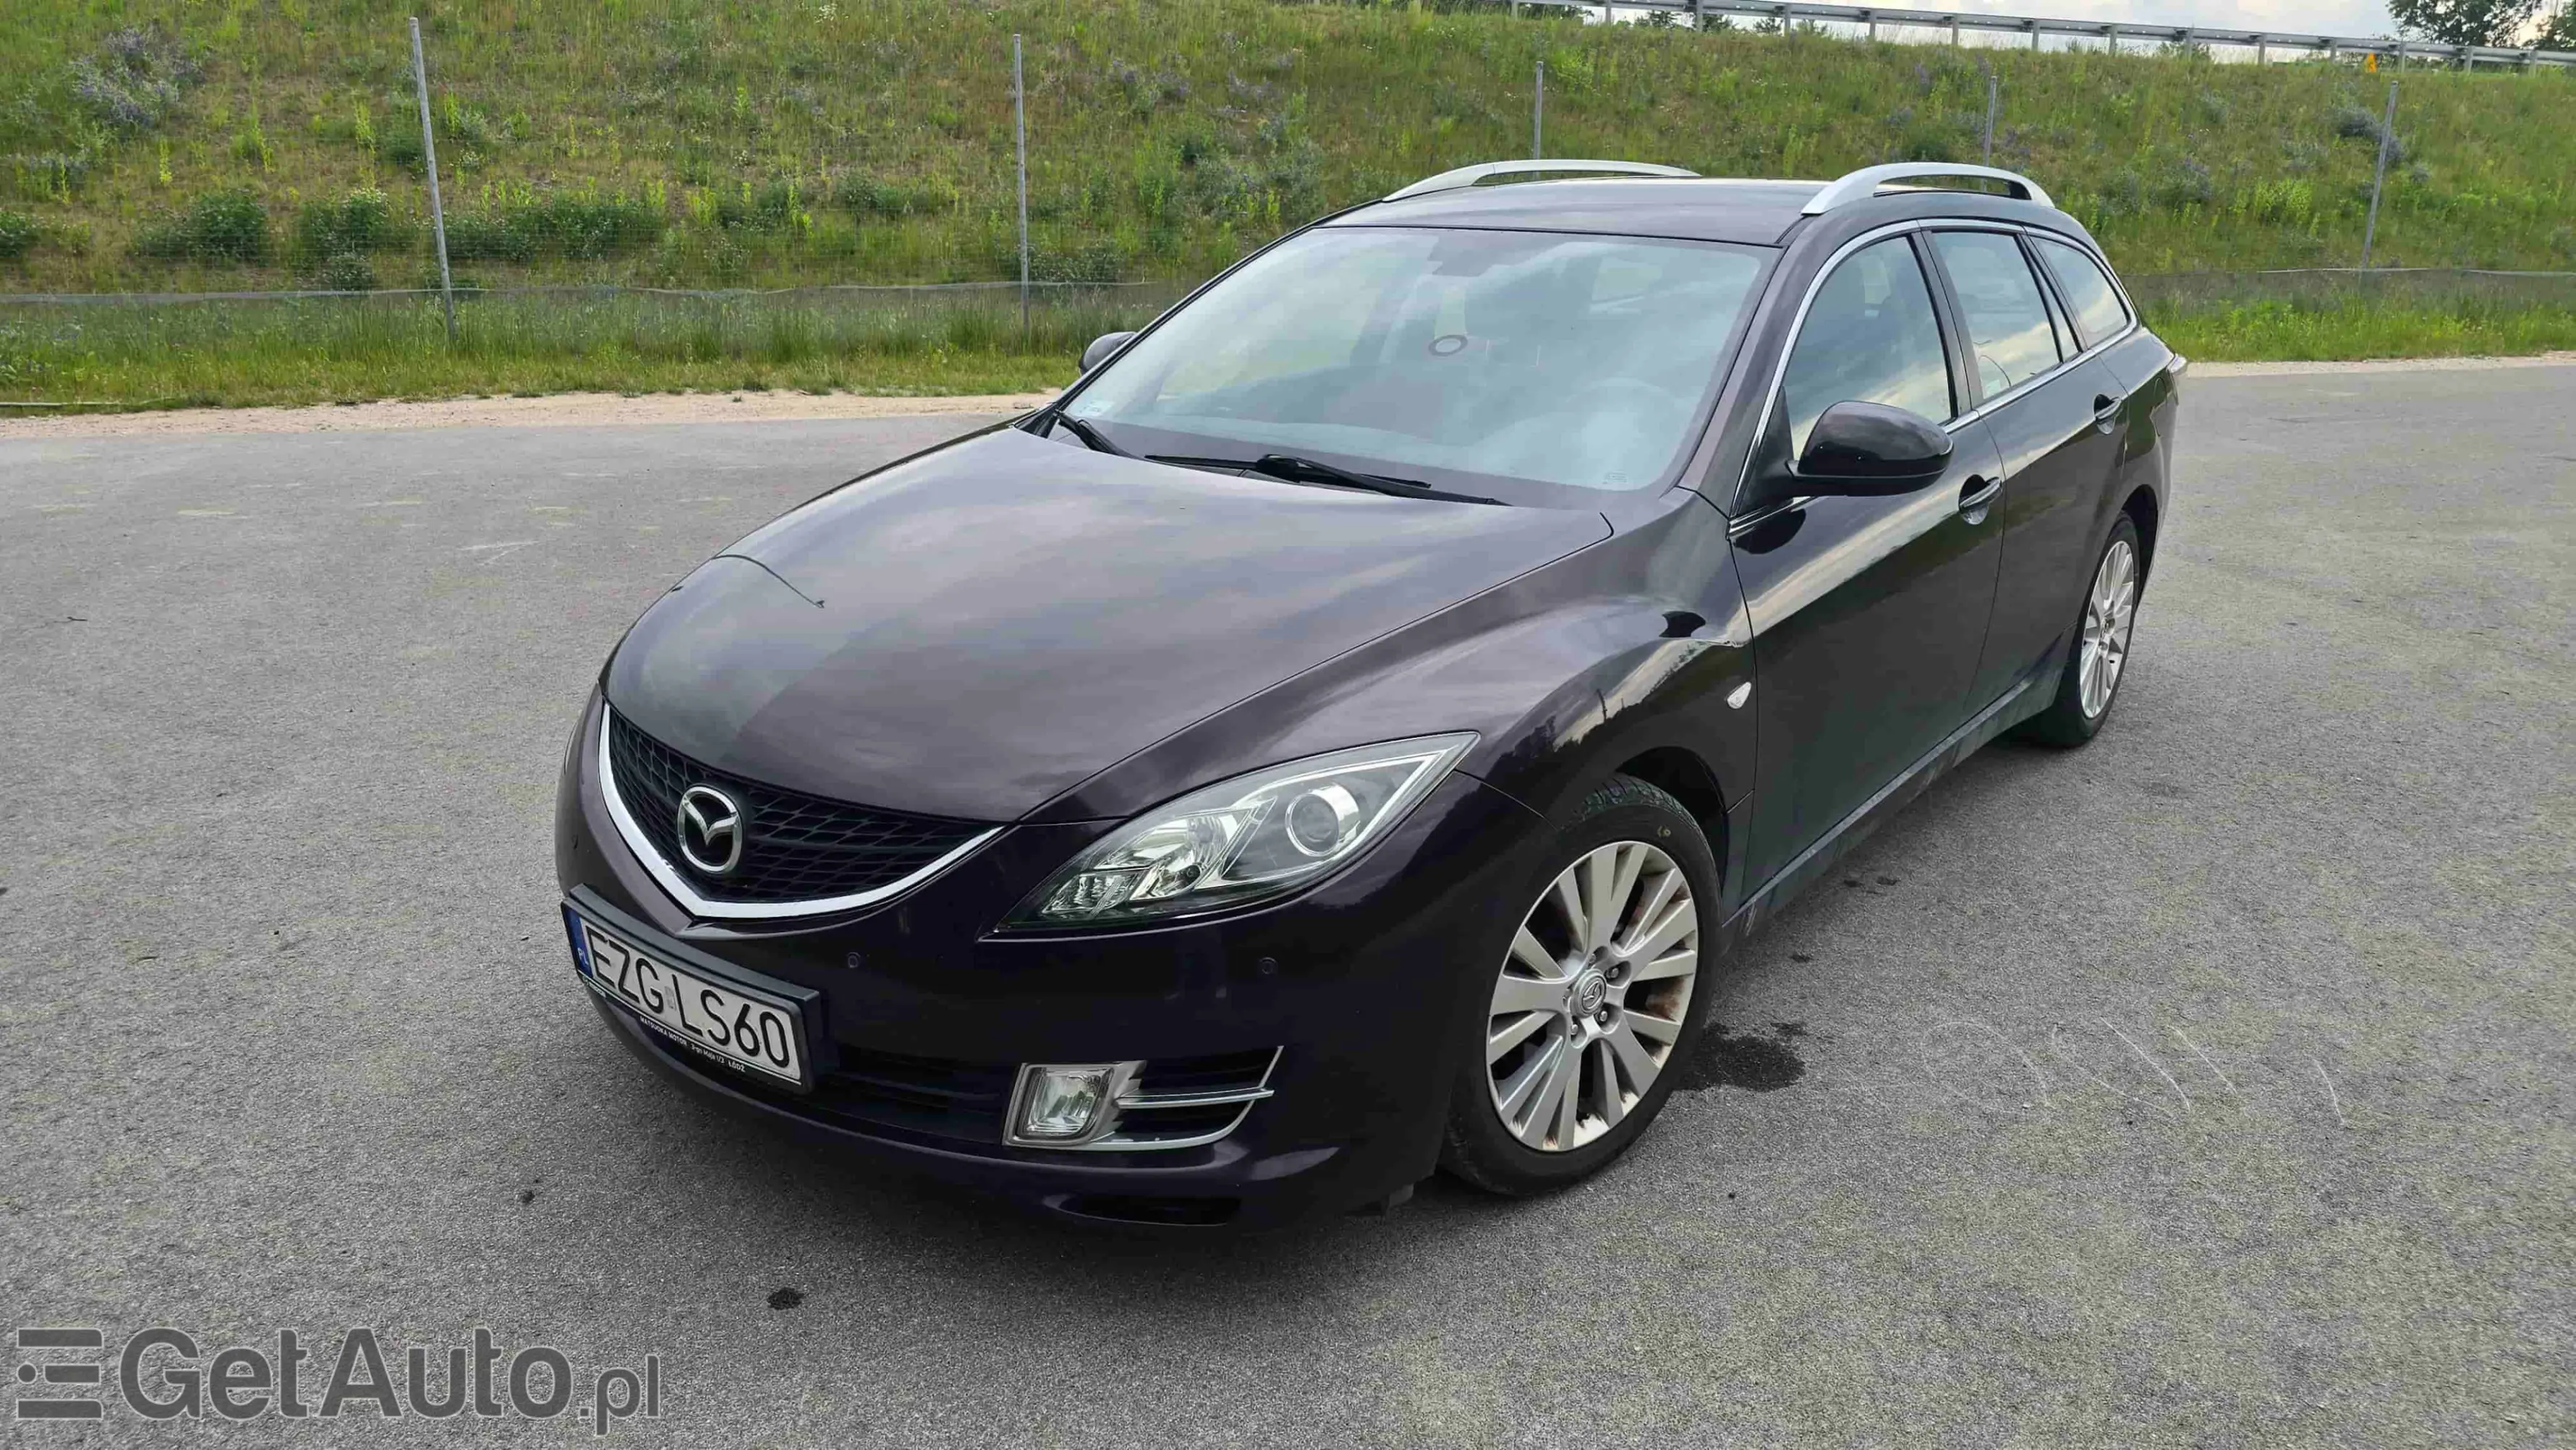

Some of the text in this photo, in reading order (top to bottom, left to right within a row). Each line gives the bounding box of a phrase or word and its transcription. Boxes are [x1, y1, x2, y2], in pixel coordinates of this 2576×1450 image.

[577, 947, 589, 965] PL
[585, 925, 790, 1068] EZG LS60
[639, 1015, 668, 1036] MATSUOKA
[668, 1031, 687, 1046] MOTOR
